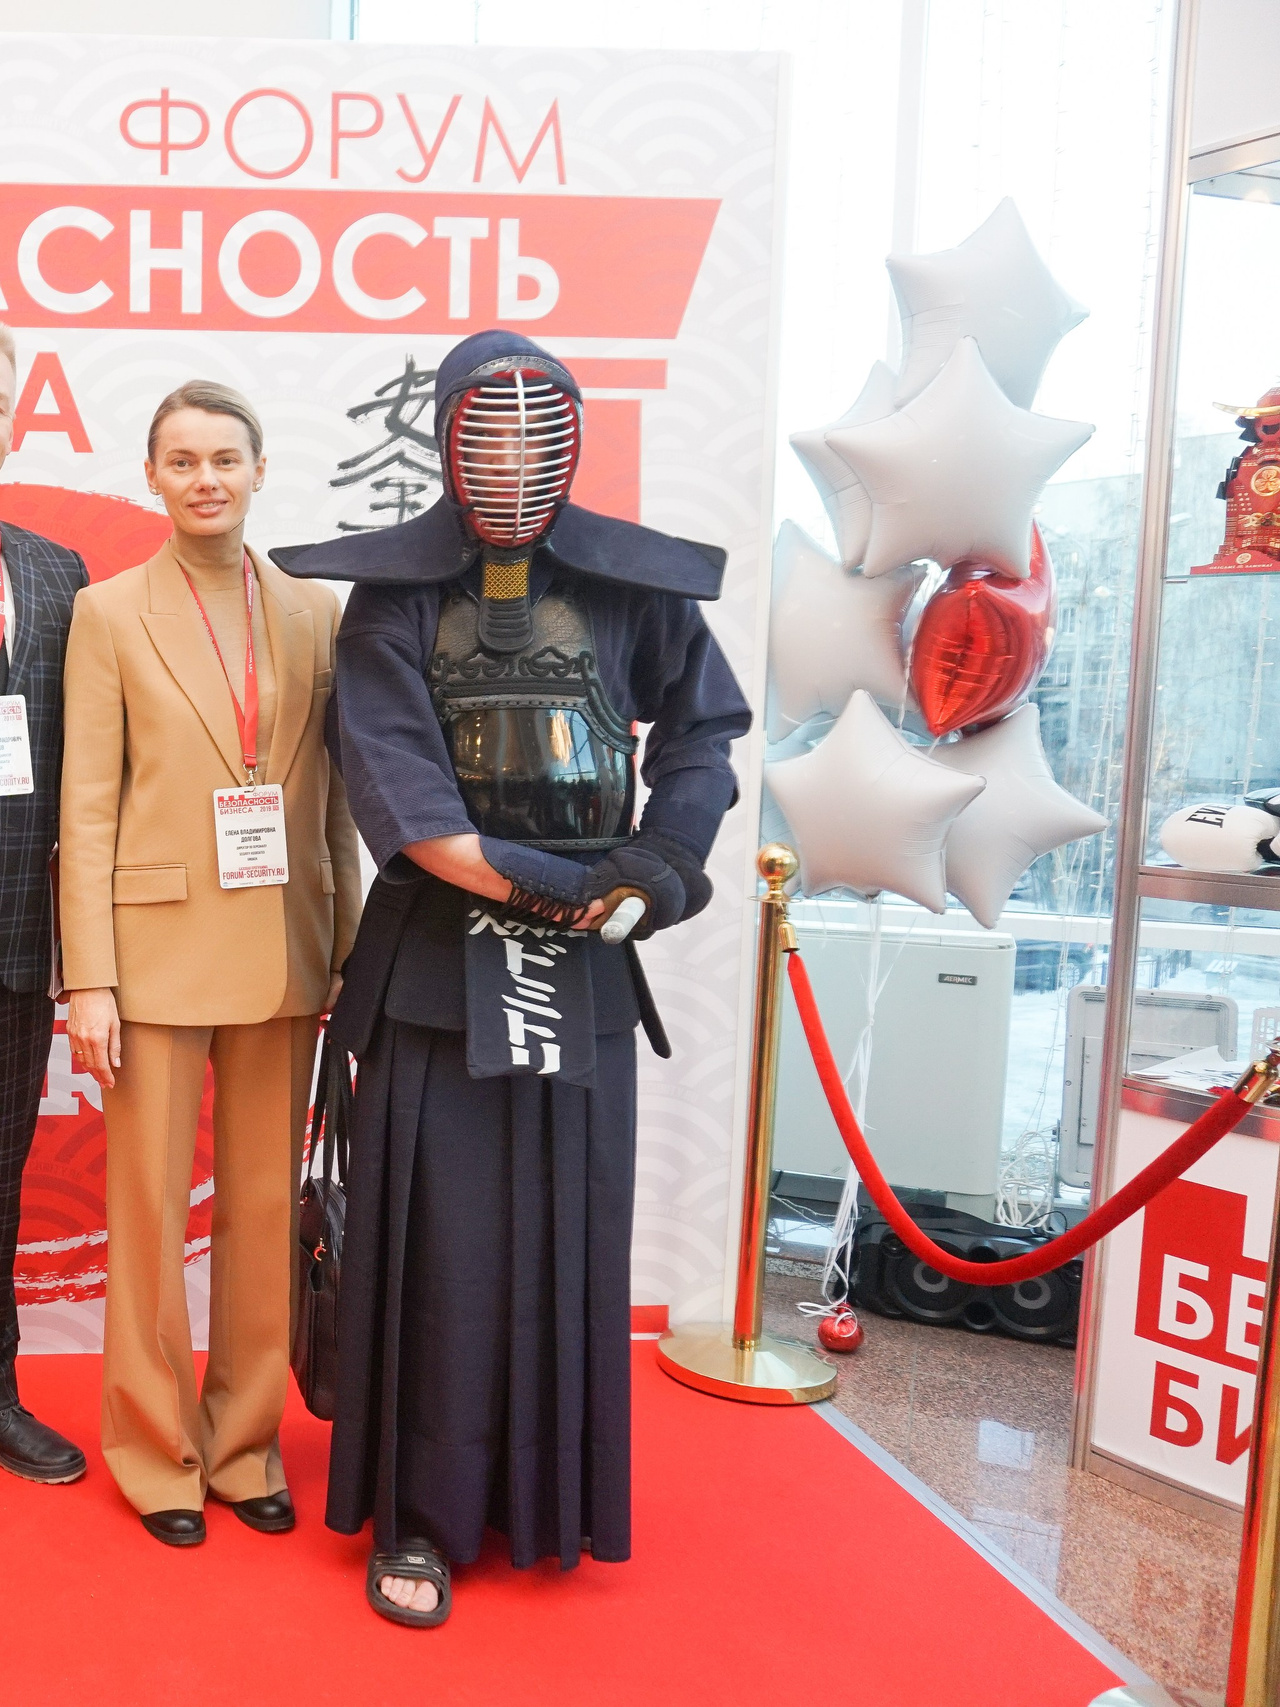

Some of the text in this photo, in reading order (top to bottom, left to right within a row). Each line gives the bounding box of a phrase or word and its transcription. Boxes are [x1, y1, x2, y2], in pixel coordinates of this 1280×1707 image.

[120, 88, 567, 186] ФОРУМ
[219, 797, 279, 808] БЕЗОПАСНОСТЬ
[220, 807, 253, 815] БИЗНЕСА
[223, 868, 285, 880] FORUM-SECURITY.RU
